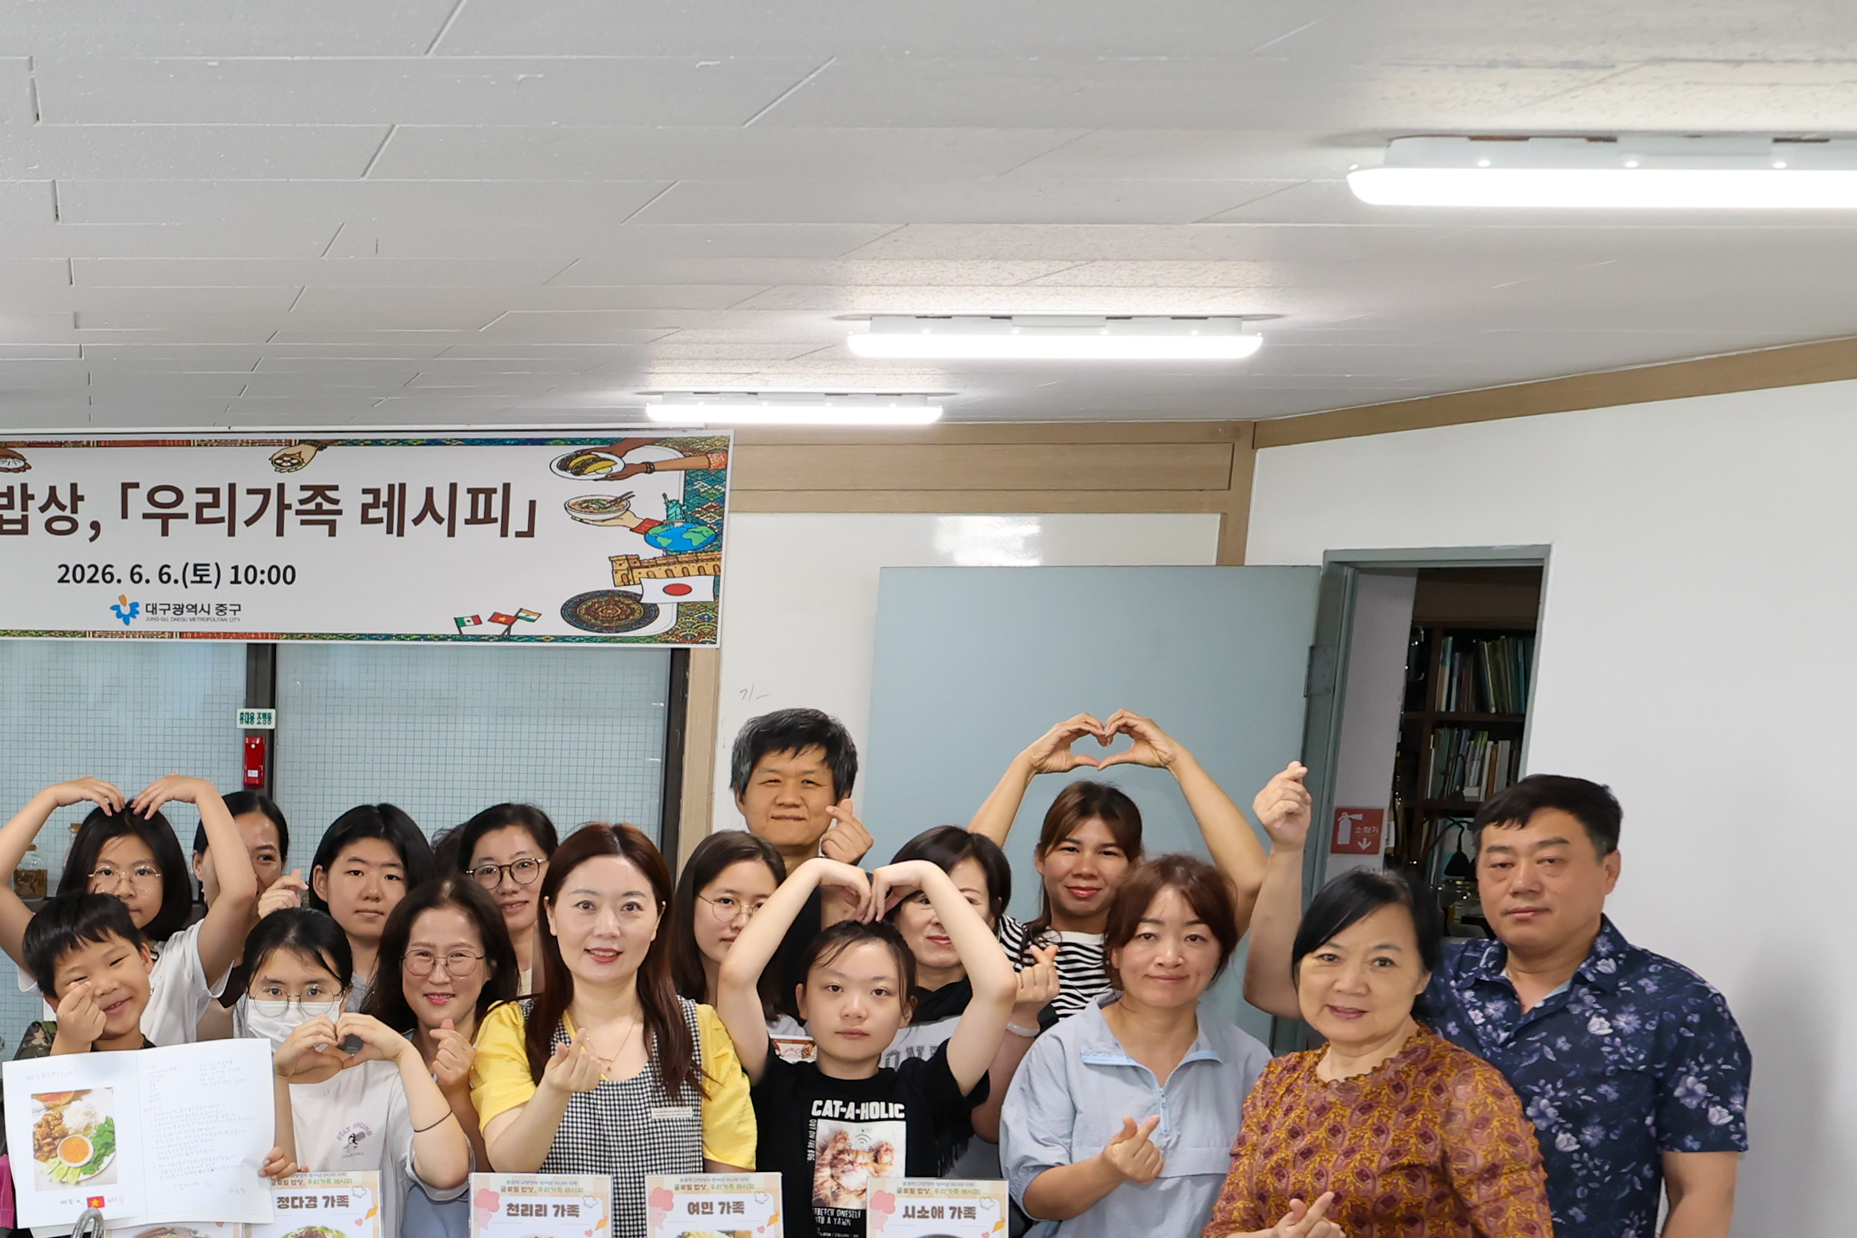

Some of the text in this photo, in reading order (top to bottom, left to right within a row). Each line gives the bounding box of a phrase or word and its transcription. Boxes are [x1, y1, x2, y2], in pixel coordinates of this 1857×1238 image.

[121, 482, 343, 537] 「우리가족
[360, 482, 537, 538] 레시피」
[57, 562, 296, 589] 2026. 6. 6.(토) 10:00
[145, 602, 241, 615] 대구광역시 중구
[811, 1100, 905, 1120] CAT-A-HOLIC
[322, 1195, 349, 1208] 가족
[687, 1201, 745, 1215] 여민 가족
[506, 1203, 579, 1218] 천리리 가족
[903, 1205, 976, 1220] 시소애 가족
